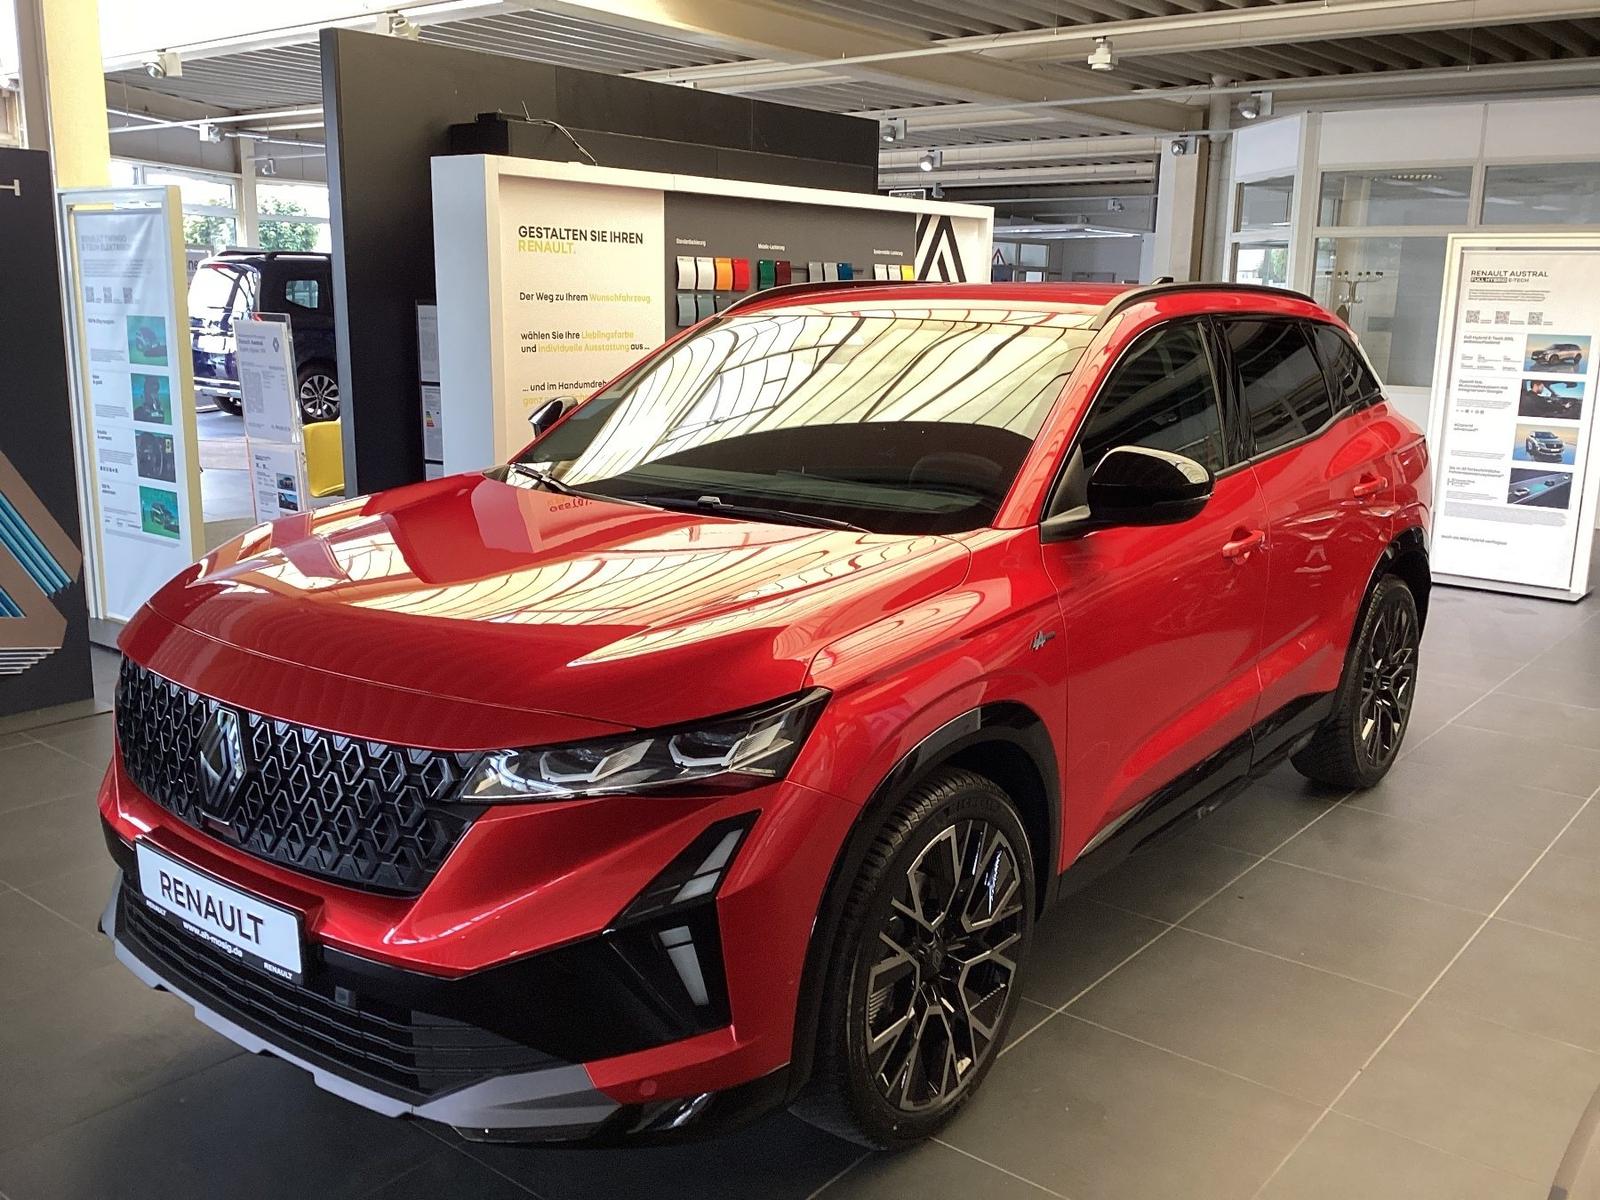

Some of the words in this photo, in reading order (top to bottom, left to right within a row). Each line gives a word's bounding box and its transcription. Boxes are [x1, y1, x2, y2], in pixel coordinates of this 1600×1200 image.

[518, 225, 588, 241] GESTALTEN
[590, 230, 608, 242] SIE
[610, 231, 643, 244] IHREN
[518, 240, 576, 254] RENAULT.
[1509, 270, 1549, 278] AUSTRAL
[519, 292, 534, 301] Der
[536, 292, 554, 303] Weg
[566, 293, 588, 301] Ihrem
[520, 331, 550, 340] wählen
[552, 331, 564, 340] Sie
[565, 331, 580, 340] Ihre
[582, 330, 634, 341] Lieblingsfarbe
[521, 344, 537, 353] und
[538, 343, 583, 353] individuelle
[584, 343, 630, 353] Ausstattung
[530, 382, 545, 391] und
[547, 382, 556, 390] im
[558, 380, 607, 391] Handumdreh
[159, 870, 264, 945] RENAULT
[263, 962, 293, 980] RENAULT
